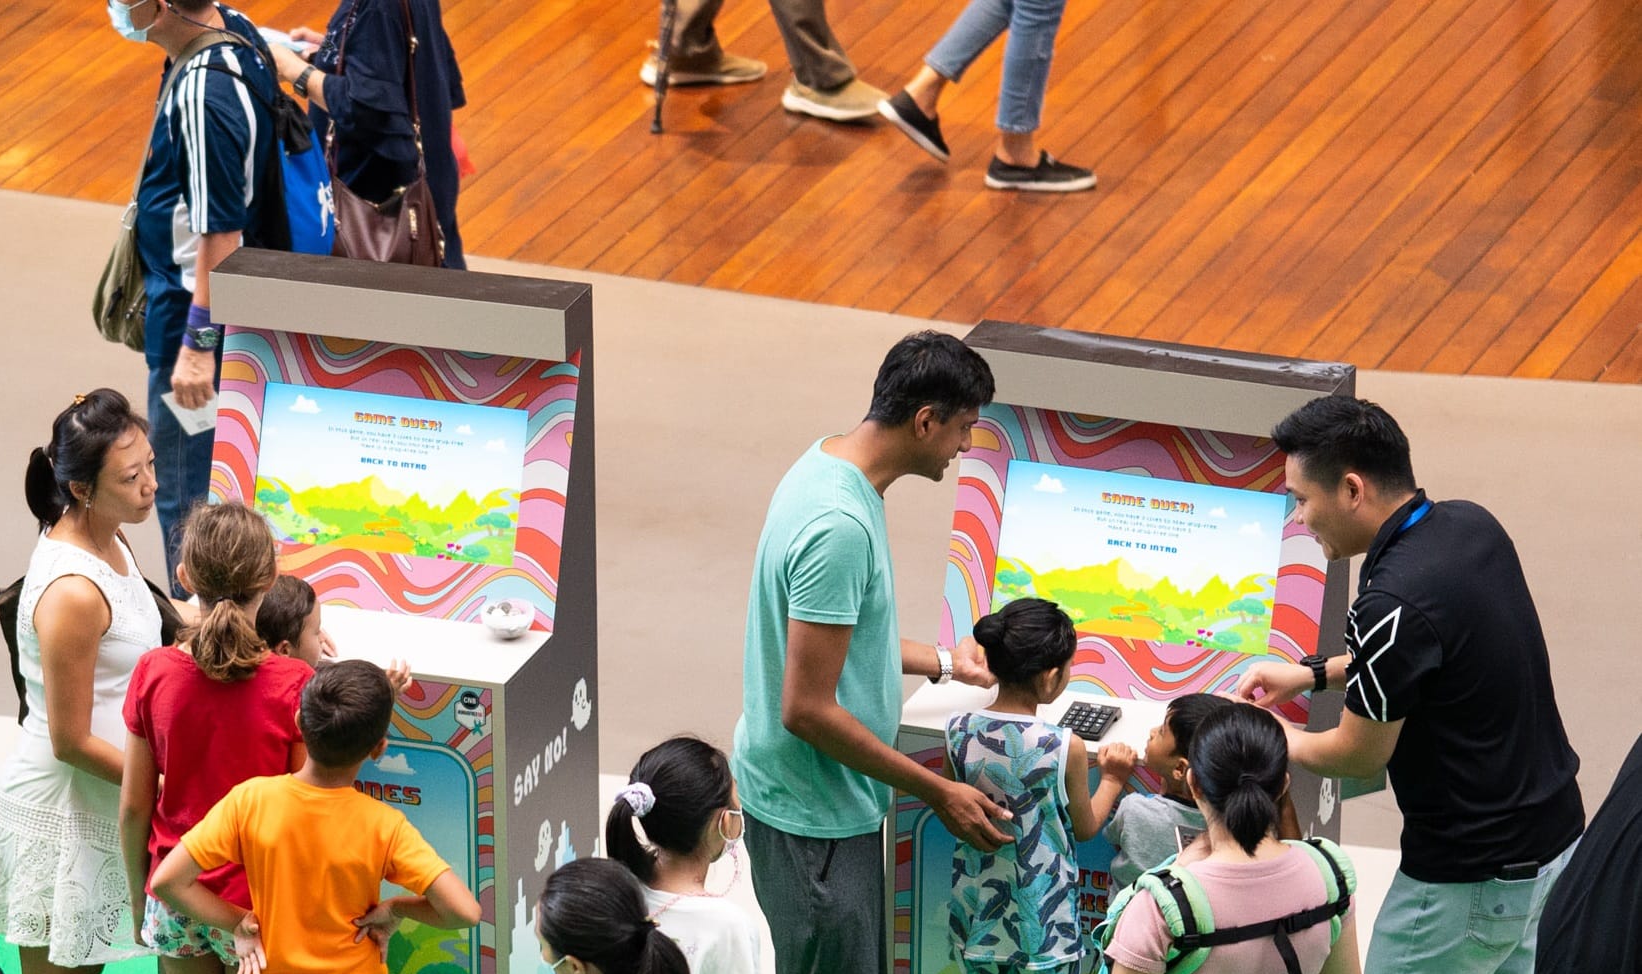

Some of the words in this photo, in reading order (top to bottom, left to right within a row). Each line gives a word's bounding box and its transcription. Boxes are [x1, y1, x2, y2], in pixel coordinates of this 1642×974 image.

[354, 411, 397, 427] GAME
[399, 417, 443, 433] OVER!
[361, 457, 384, 465] BACK
[387, 459, 399, 468] TO
[401, 461, 427, 471] INTRO
[1102, 492, 1146, 508] GAME
[1150, 498, 1195, 515] OVER!
[1107, 538, 1132, 548] BACK
[1135, 542, 1148, 551] TO
[1150, 544, 1178, 554] INTRO
[514, 753, 541, 806] SAY
[545, 726, 567, 775] NO!
